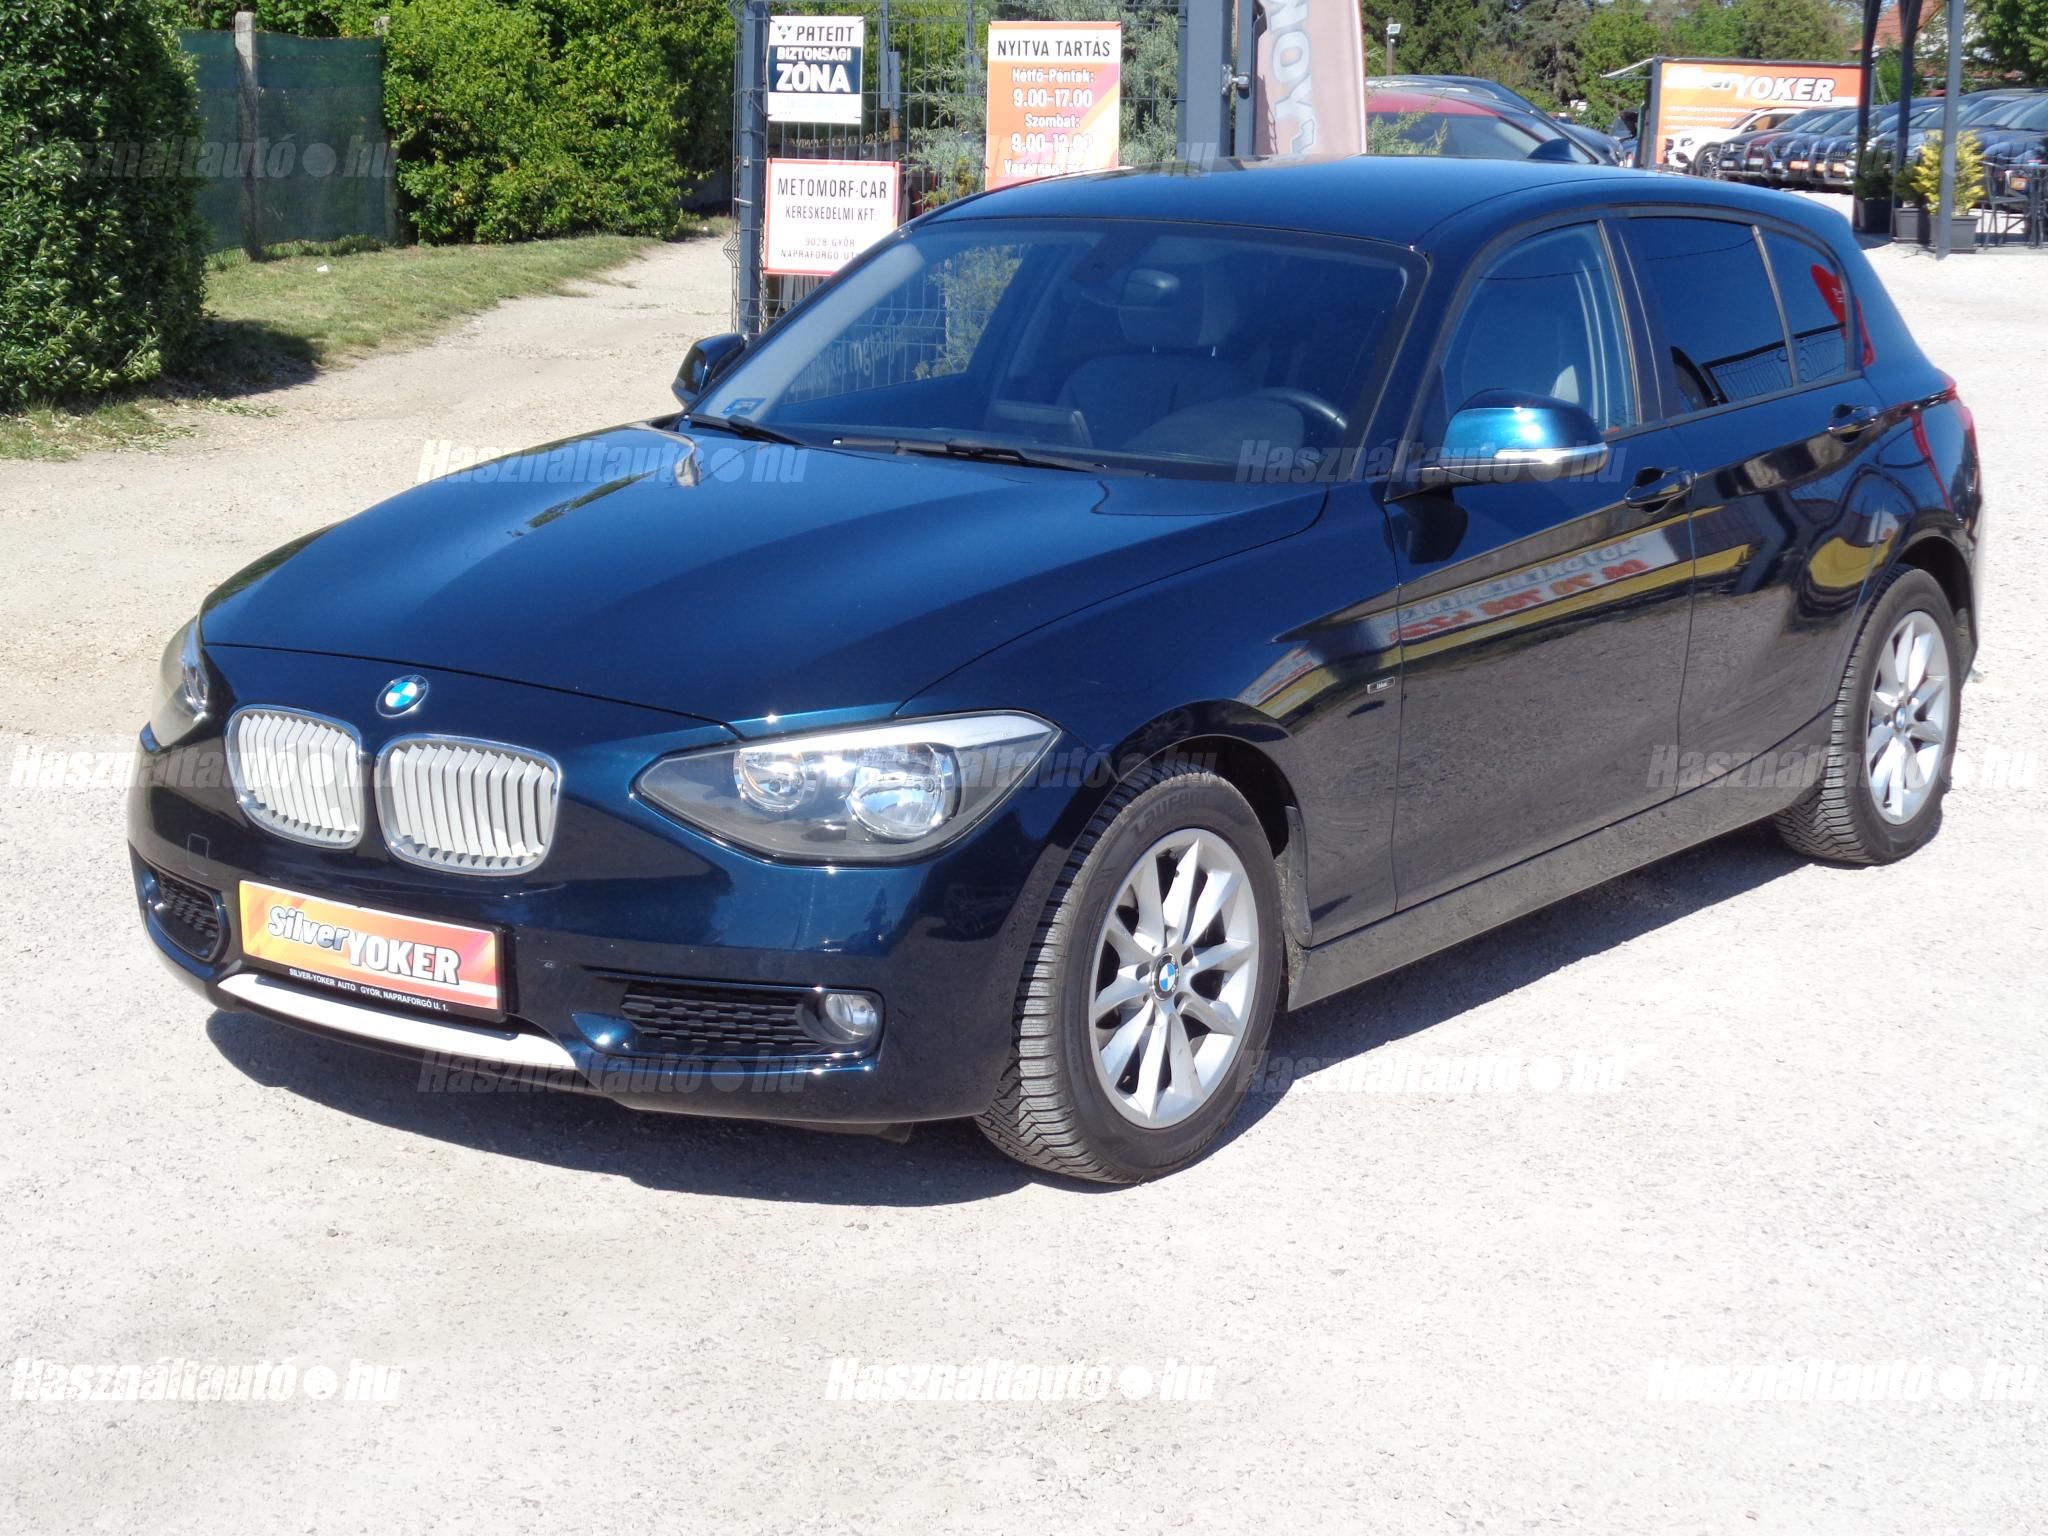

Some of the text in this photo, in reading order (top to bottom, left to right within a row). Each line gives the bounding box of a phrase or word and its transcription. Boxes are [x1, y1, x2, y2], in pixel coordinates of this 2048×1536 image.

[796, 25, 855, 42] PATENT
[776, 45, 852, 61] BIZTONSÁGI
[997, 39, 1050, 57] NYITVA
[775, 60, 852, 93] ZÓNA
[777, 177, 888, 199] METOMORF-CAR
[785, 205, 855, 221] KERESKEDELMI
[288, 967, 336, 988] SILVER-YOKER
